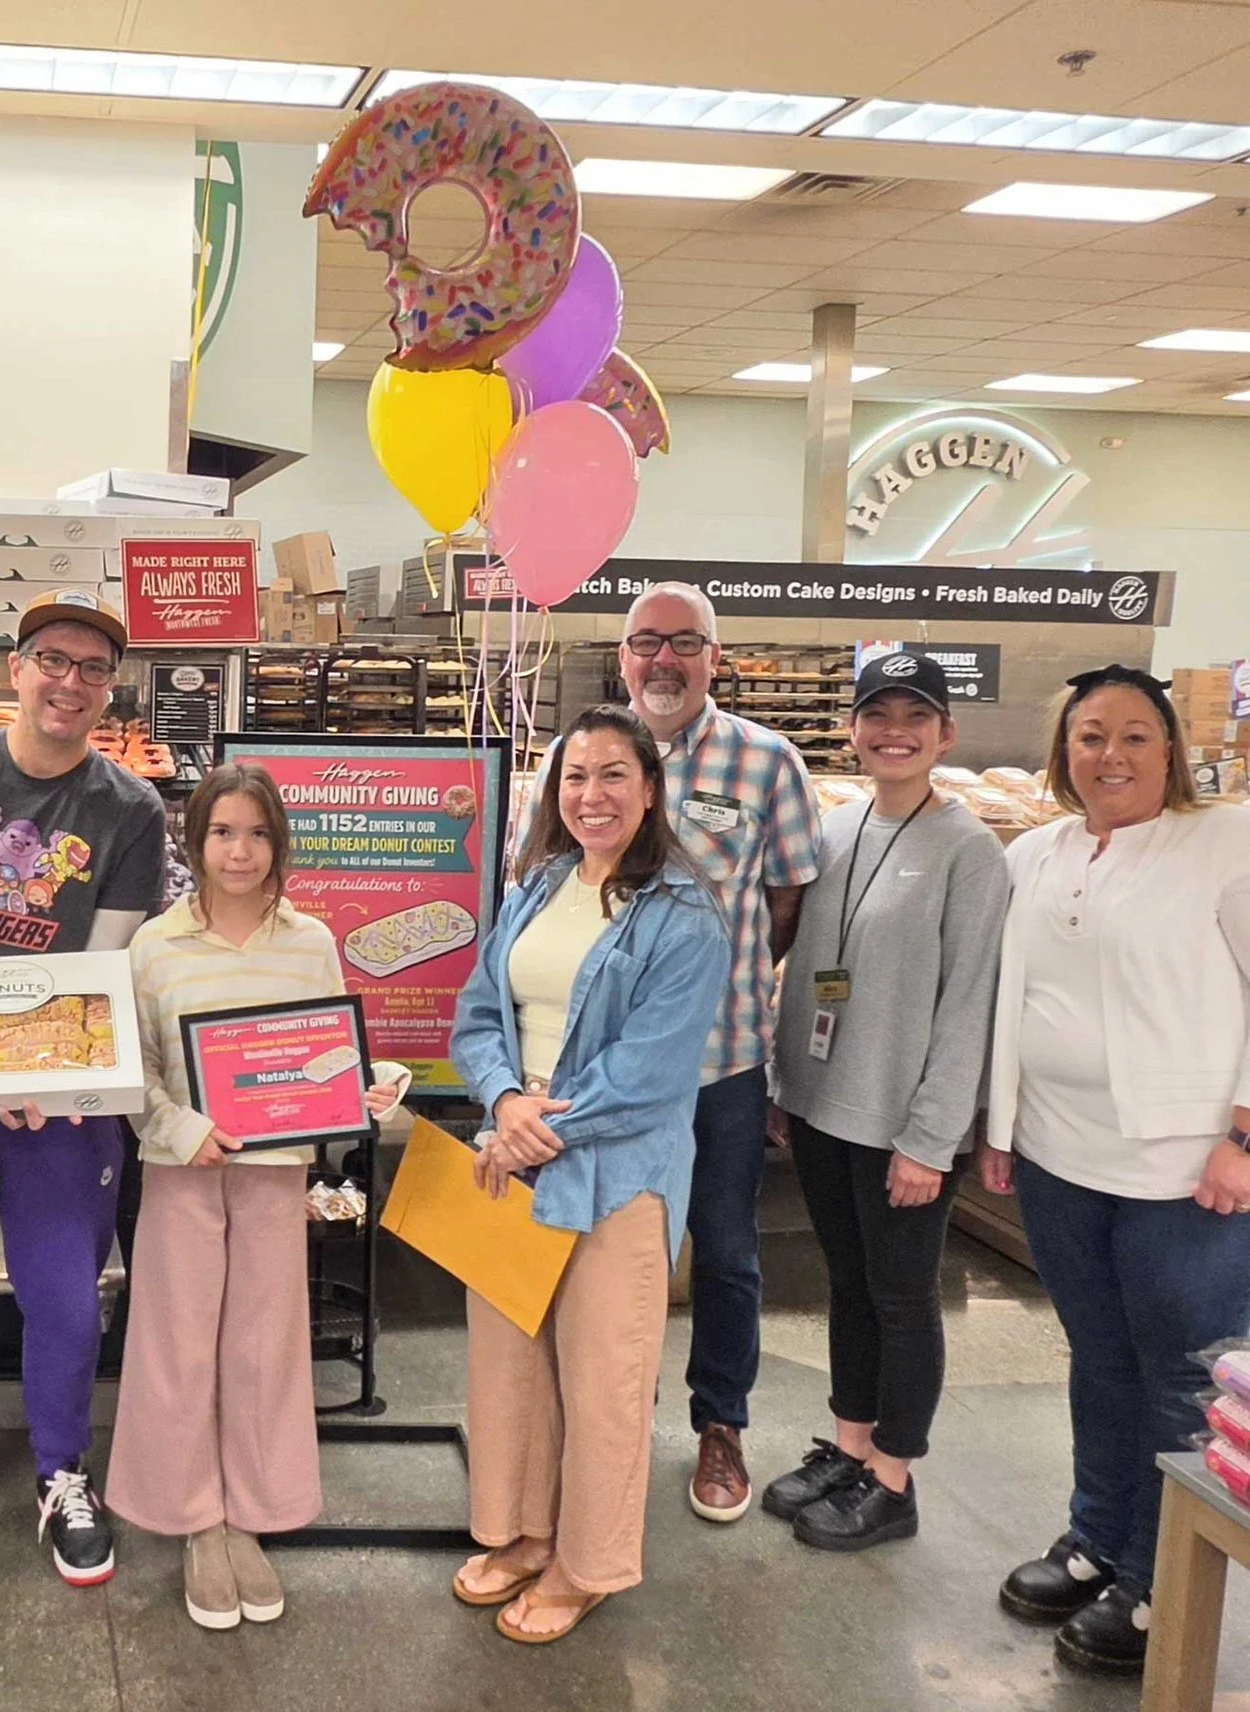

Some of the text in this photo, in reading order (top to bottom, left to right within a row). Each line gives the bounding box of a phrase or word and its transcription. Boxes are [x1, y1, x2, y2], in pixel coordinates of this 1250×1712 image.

[845, 432, 1032, 537] HAGGEN
[132, 556, 246, 569] MADE RIGHT HERE
[141, 571, 241, 597] ALWAYS FRESH
[706, 579, 782, 599] Custom
[786, 581, 835, 600] Cake
[840, 582, 915, 603] Designs
[935, 585, 988, 603] Fresh
[993, 586, 1051, 604] Baked
[1057, 588, 1103, 608] Daily
[151, 604, 232, 623] Haggen
[313, 761, 407, 784] Haggen
[280, 784, 439, 806] COMMUNITY GIVING
[702, 805, 725, 815] Chris
[297, 819, 317, 831] HAD
[319, 812, 367, 833] 1152
[369, 820, 404, 833] ENTRIES
[405, 821, 415, 833] IN
[417, 821, 436, 833] OUR
[299, 836, 330, 851] YOUR
[332, 837, 370, 852] DREAM
[371, 838, 408, 852] DONUT
[410, 838, 456, 853] CONTEST
[316, 857, 339, 869] you
[341, 857, 349, 865] to
[350, 857, 361, 866] ALL
[361, 857, 370, 866] of
[285, 874, 427, 896] Congratulations to:
[358, 987, 391, 995] GRAND
[209, 1015, 339, 1039] Haggen COMMUNITY GIVING
[257, 1070, 303, 1083] Natalya
